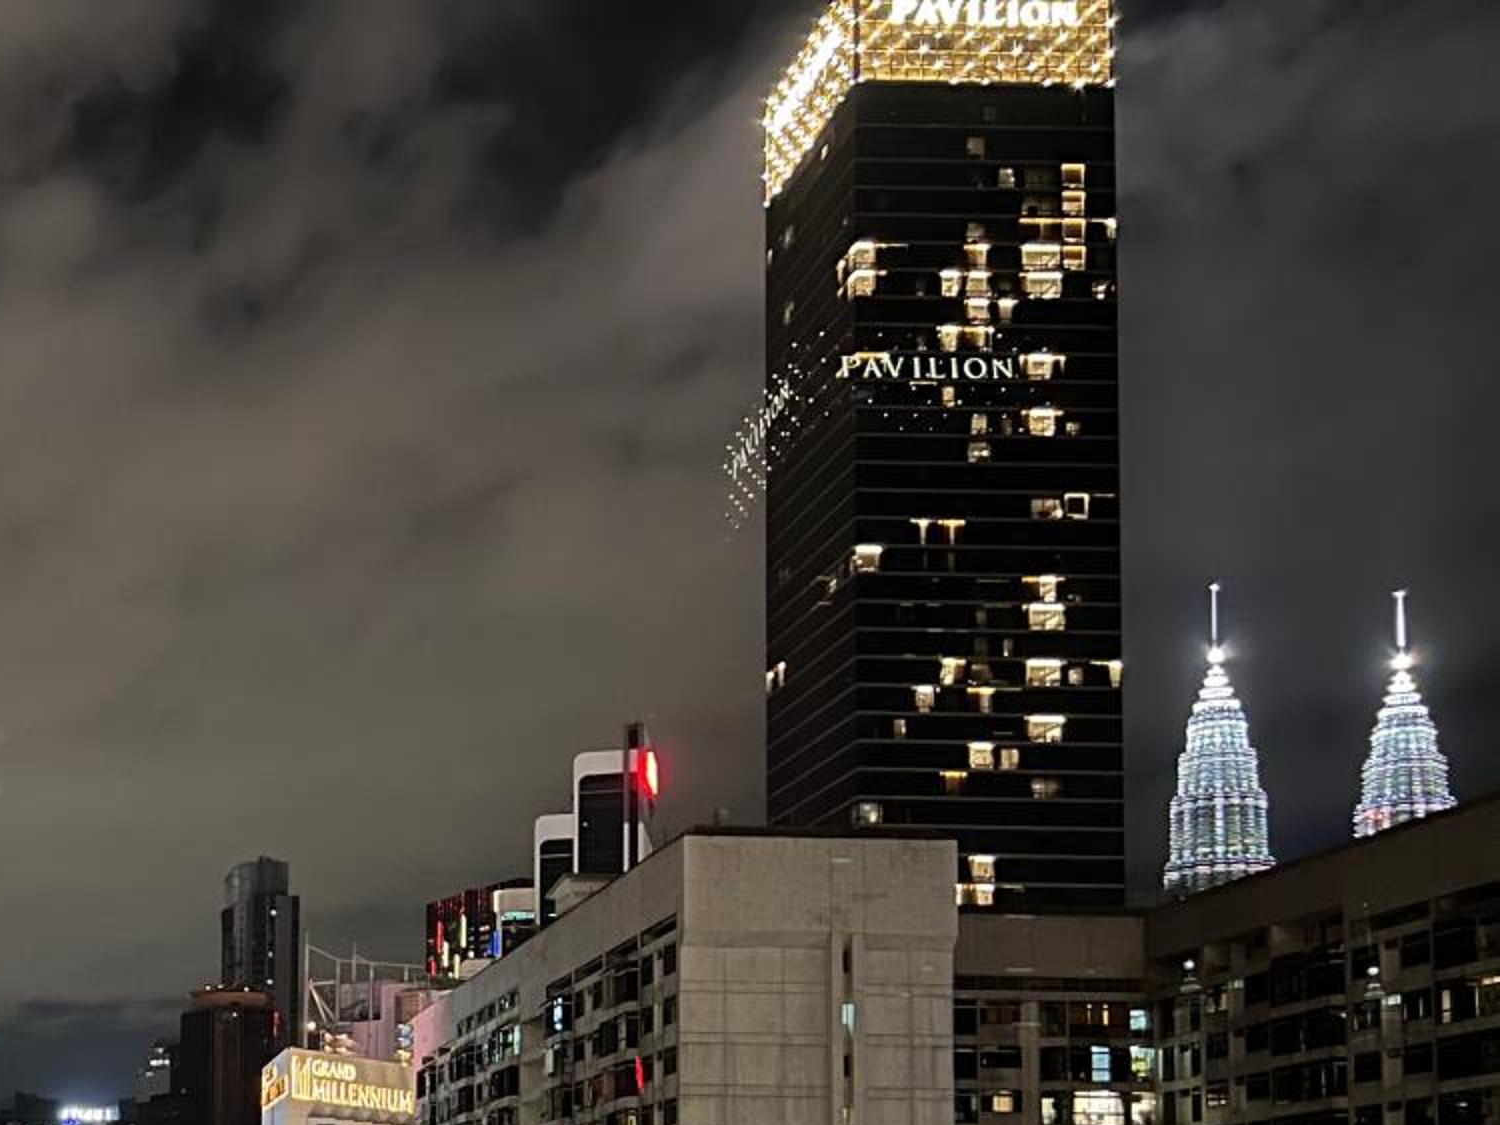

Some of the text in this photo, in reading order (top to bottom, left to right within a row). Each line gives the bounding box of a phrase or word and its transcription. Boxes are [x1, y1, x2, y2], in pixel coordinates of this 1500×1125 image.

[840, 354, 1013, 380] PAVILION
[312, 1058, 357, 1079] GRAND
[312, 1079, 415, 1114] MILLENNIUM
